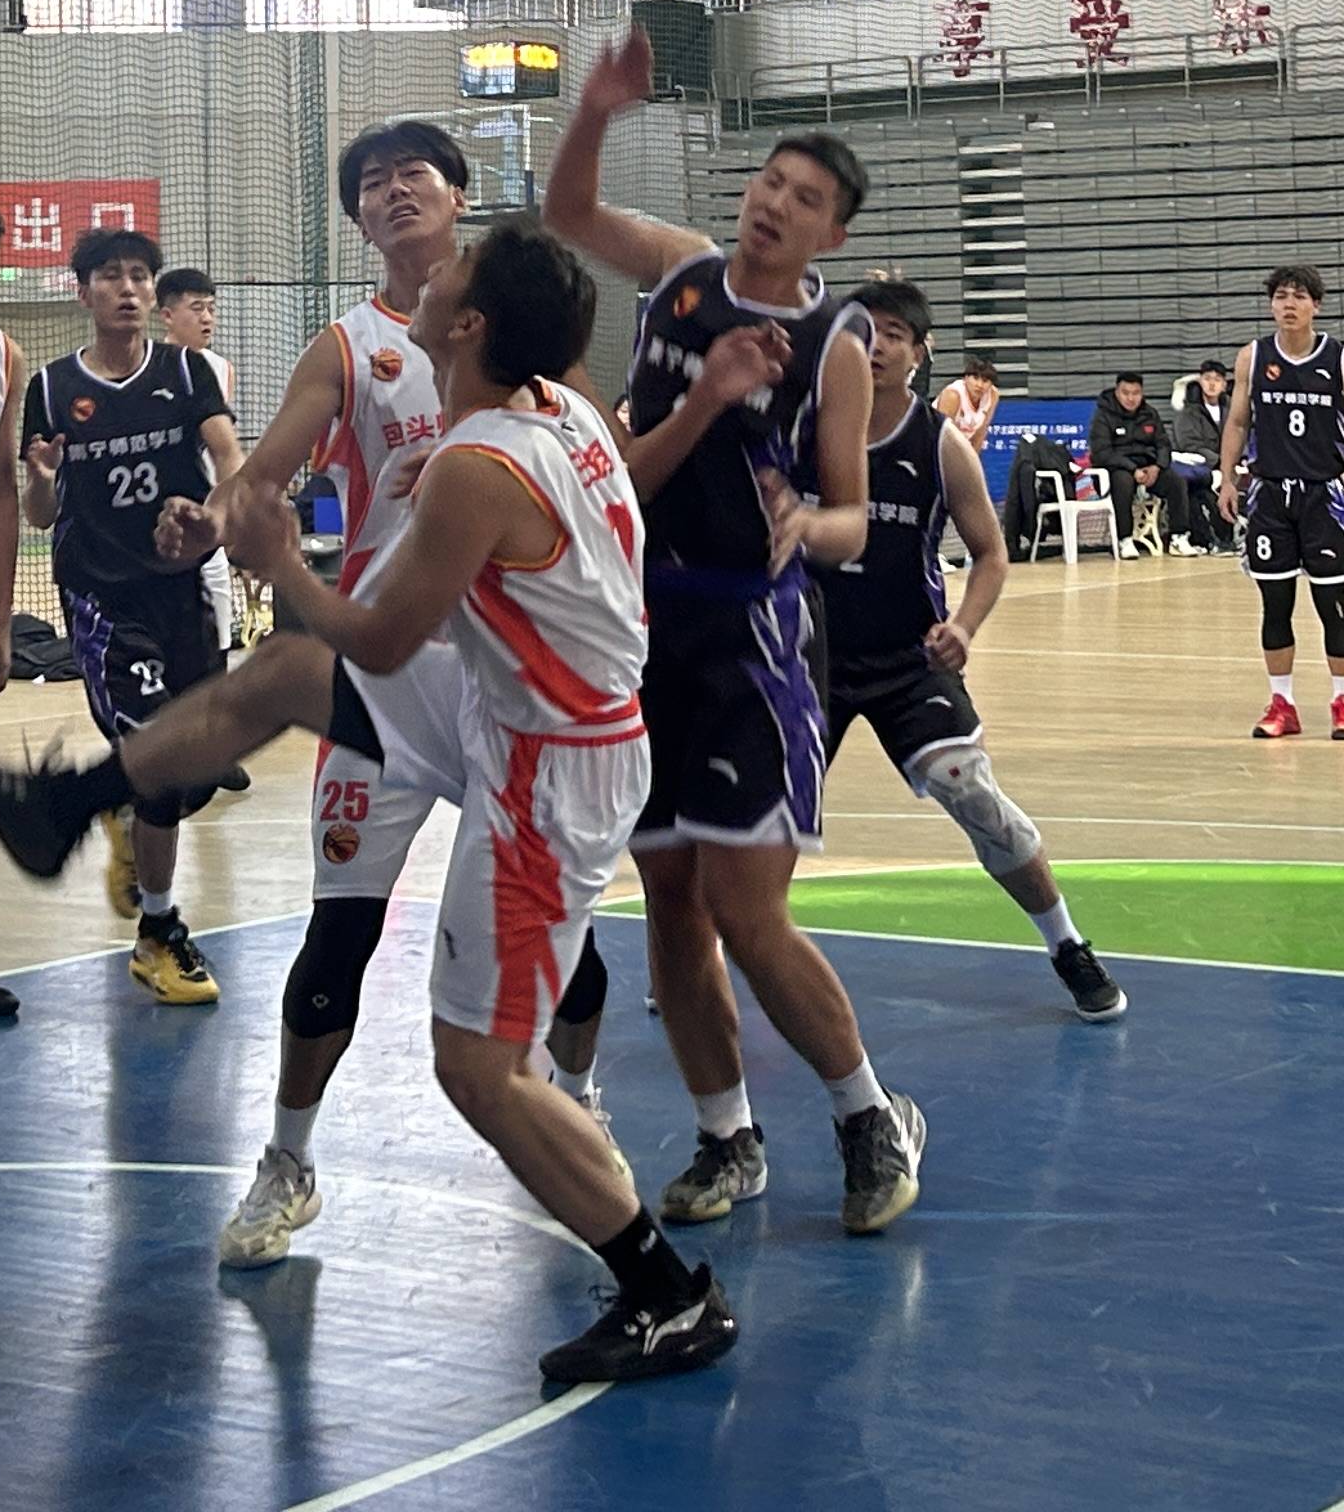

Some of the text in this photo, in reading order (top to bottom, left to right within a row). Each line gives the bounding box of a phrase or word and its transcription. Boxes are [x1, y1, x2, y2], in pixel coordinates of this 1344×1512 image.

[12, 197, 134, 252] 出口
[1289, 409, 1306, 437] 8
[108, 462, 159, 507] 23
[1257, 535, 1272, 560] 8
[320, 779, 369, 822] 25
